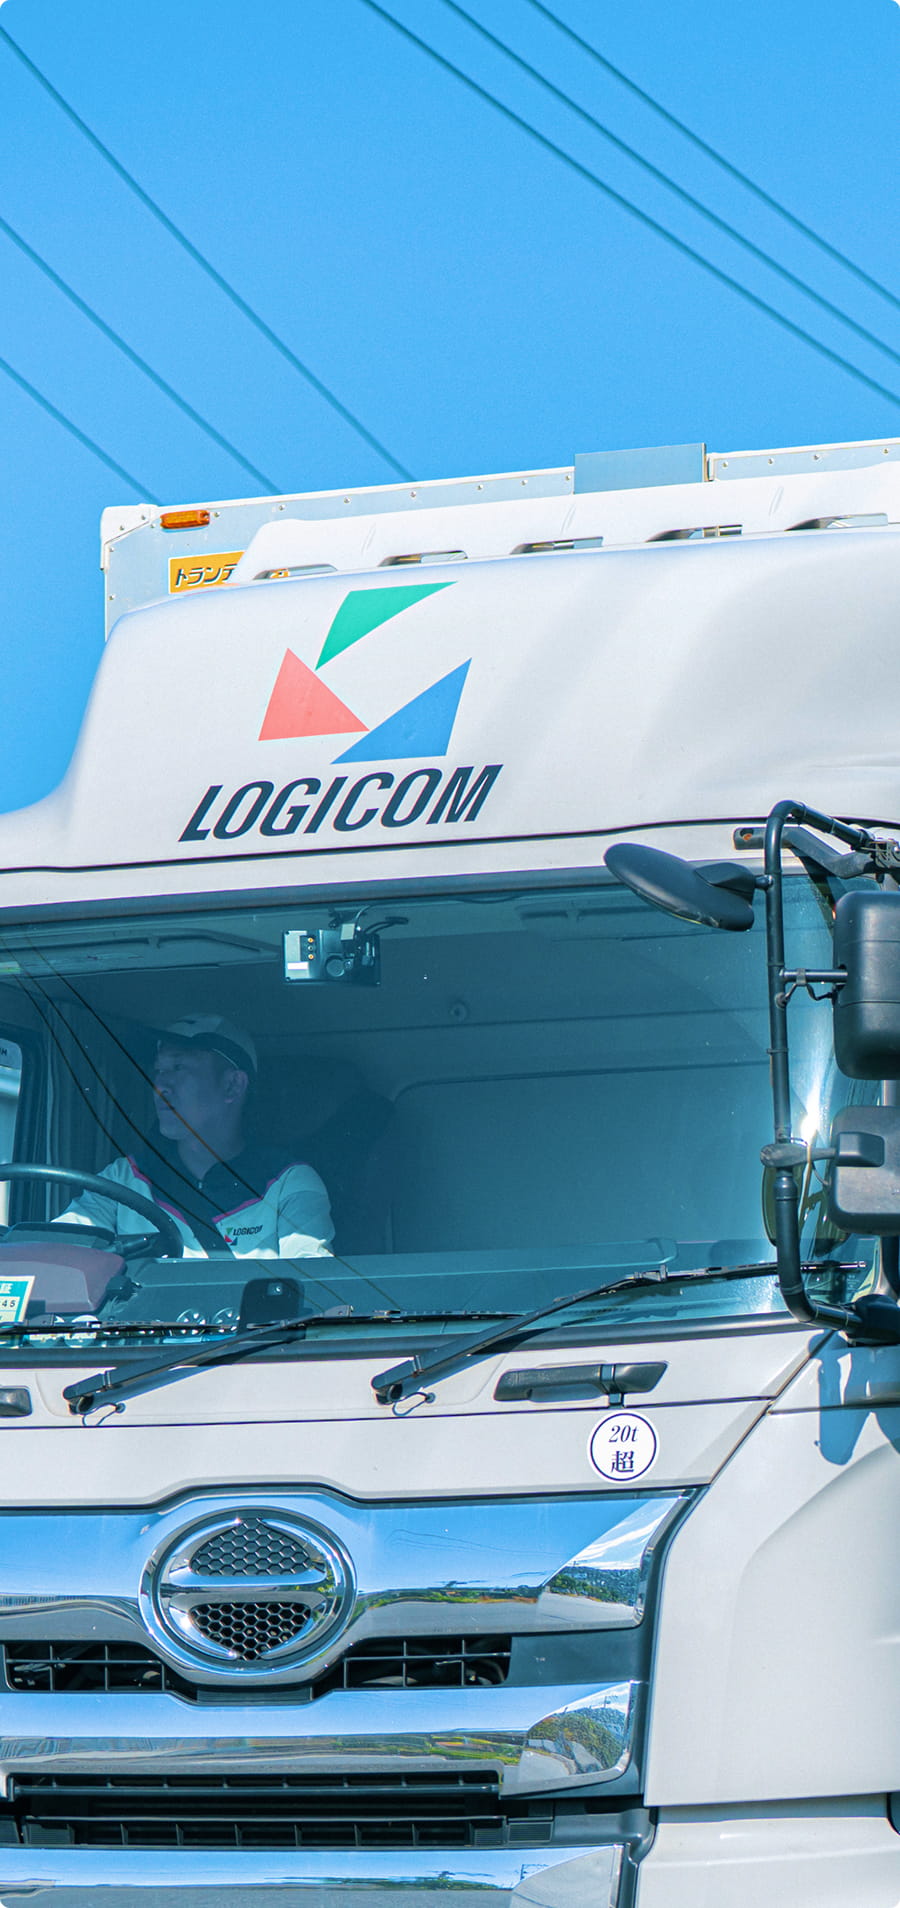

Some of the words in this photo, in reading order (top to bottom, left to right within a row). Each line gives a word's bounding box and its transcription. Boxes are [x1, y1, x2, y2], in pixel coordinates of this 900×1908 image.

[178, 764, 503, 842] LOGICOM
[608, 1425, 639, 1443] 20t
[611, 1450, 635, 1474] 超
